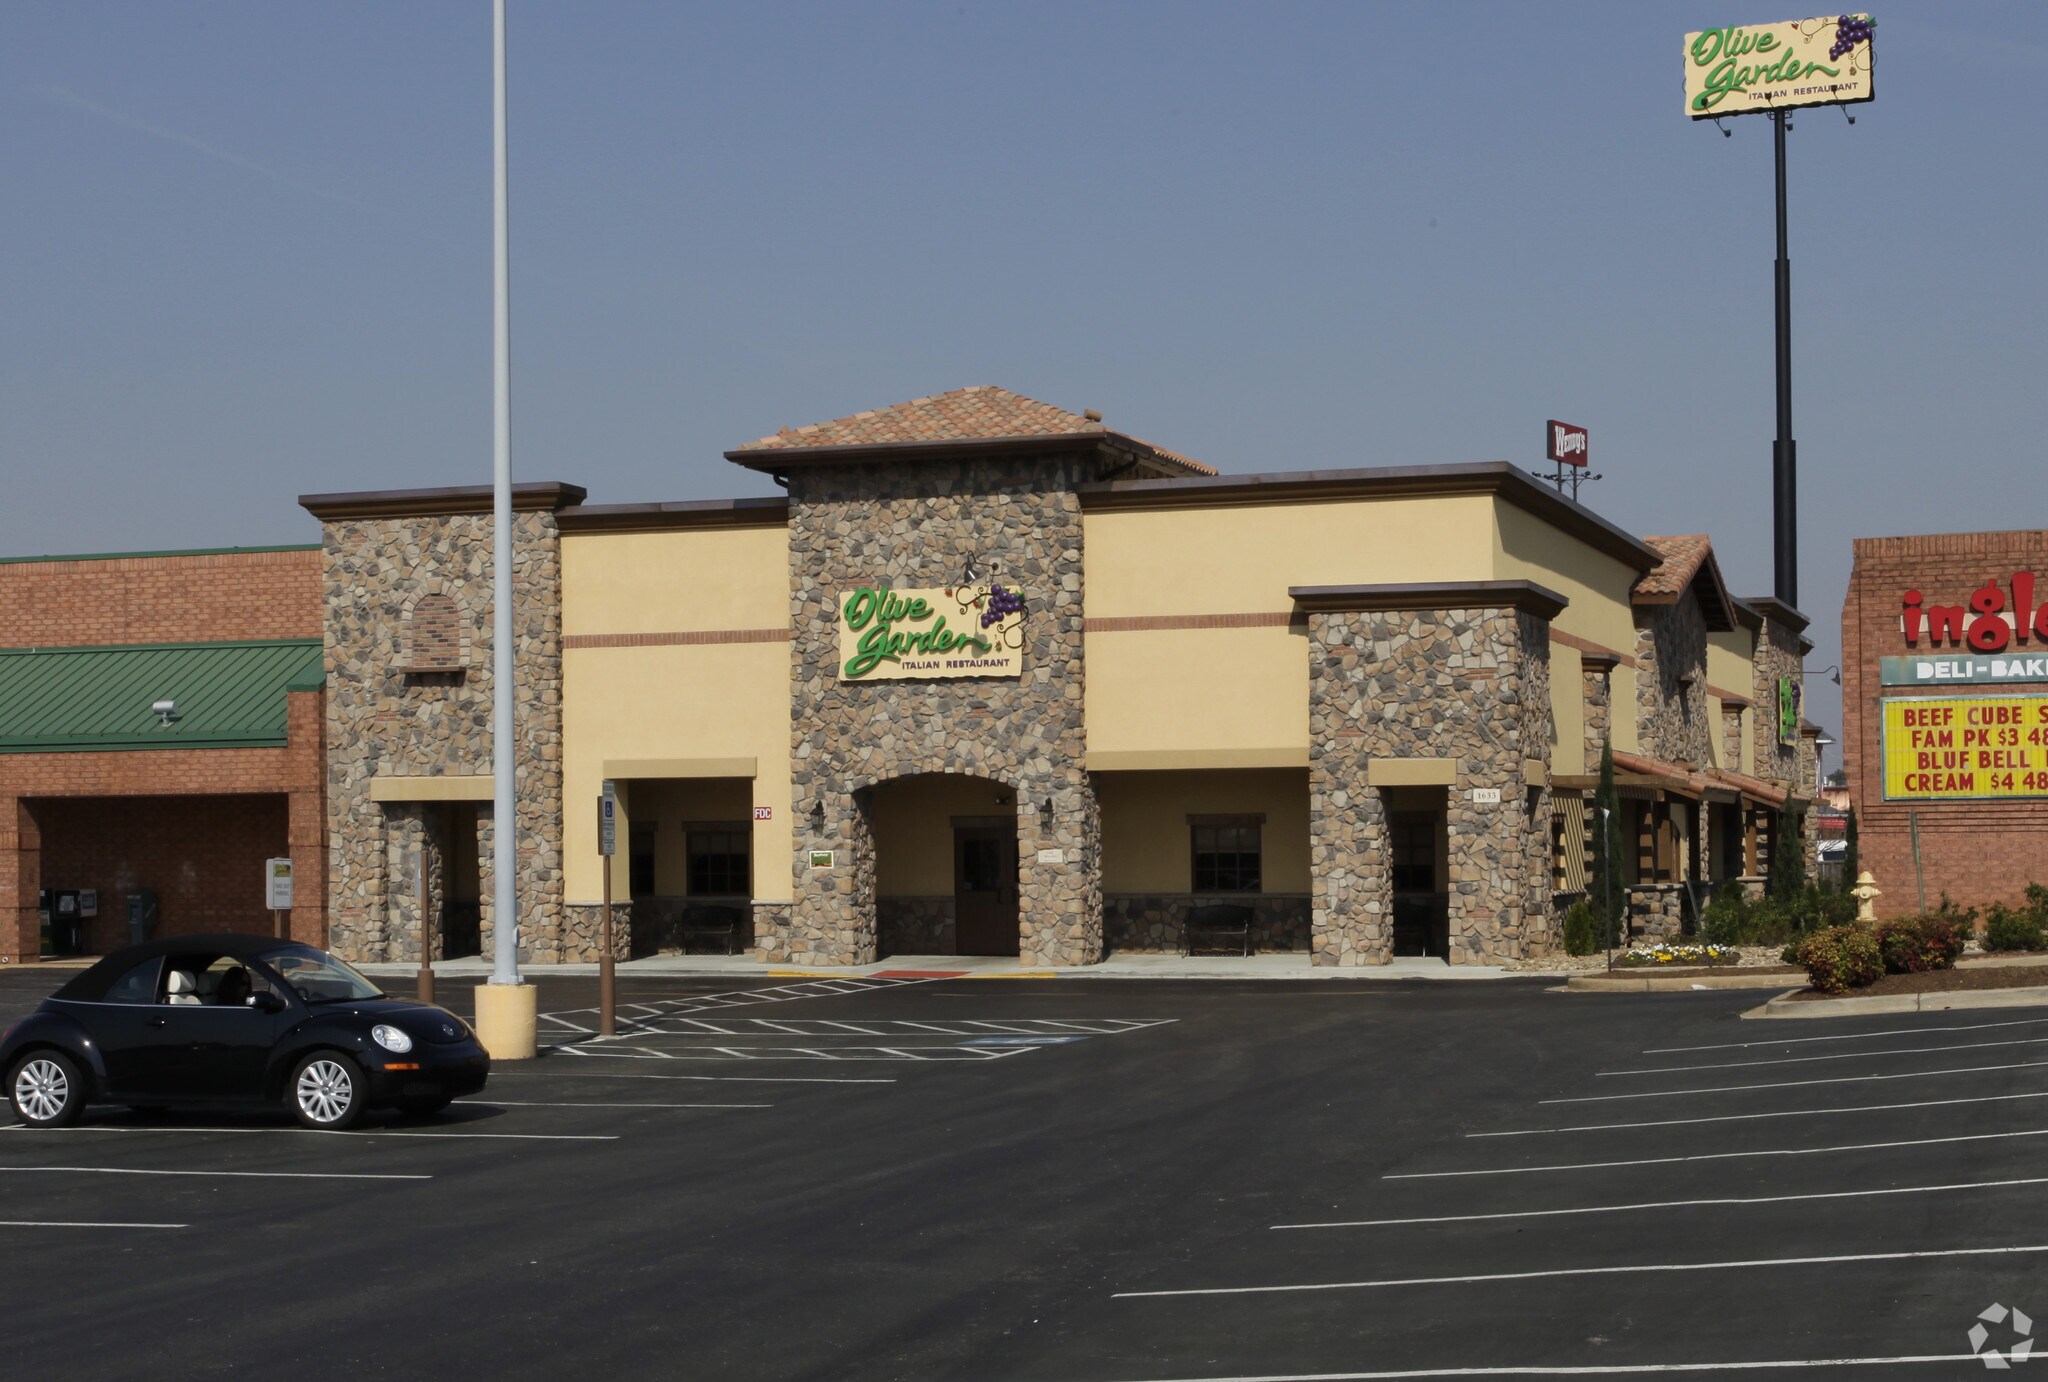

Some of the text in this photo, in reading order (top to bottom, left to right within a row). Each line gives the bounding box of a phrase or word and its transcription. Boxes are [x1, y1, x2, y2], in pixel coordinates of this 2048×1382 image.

[1691, 24, 1781, 66] Olive
[1748, 82, 1858, 100] ITAAN RESTAUANT
[843, 585, 934, 628] Olive
[902, 658, 1010, 670] ITALIAN RESTAURANT
[1904, 707, 1953, 727] BEEF
[1967, 706, 2022, 726] CUBE
[1911, 729, 1953, 748] FAM
[1963, 728, 1990, 747] PK
[1998, 727, 2019, 746] $3
[1979, 749, 2030, 769] BELL
[1904, 771, 2048, 792] CREAM $4 48
[1478, 792, 1496, 800] 1633
[754, 808, 771, 819] FDC
